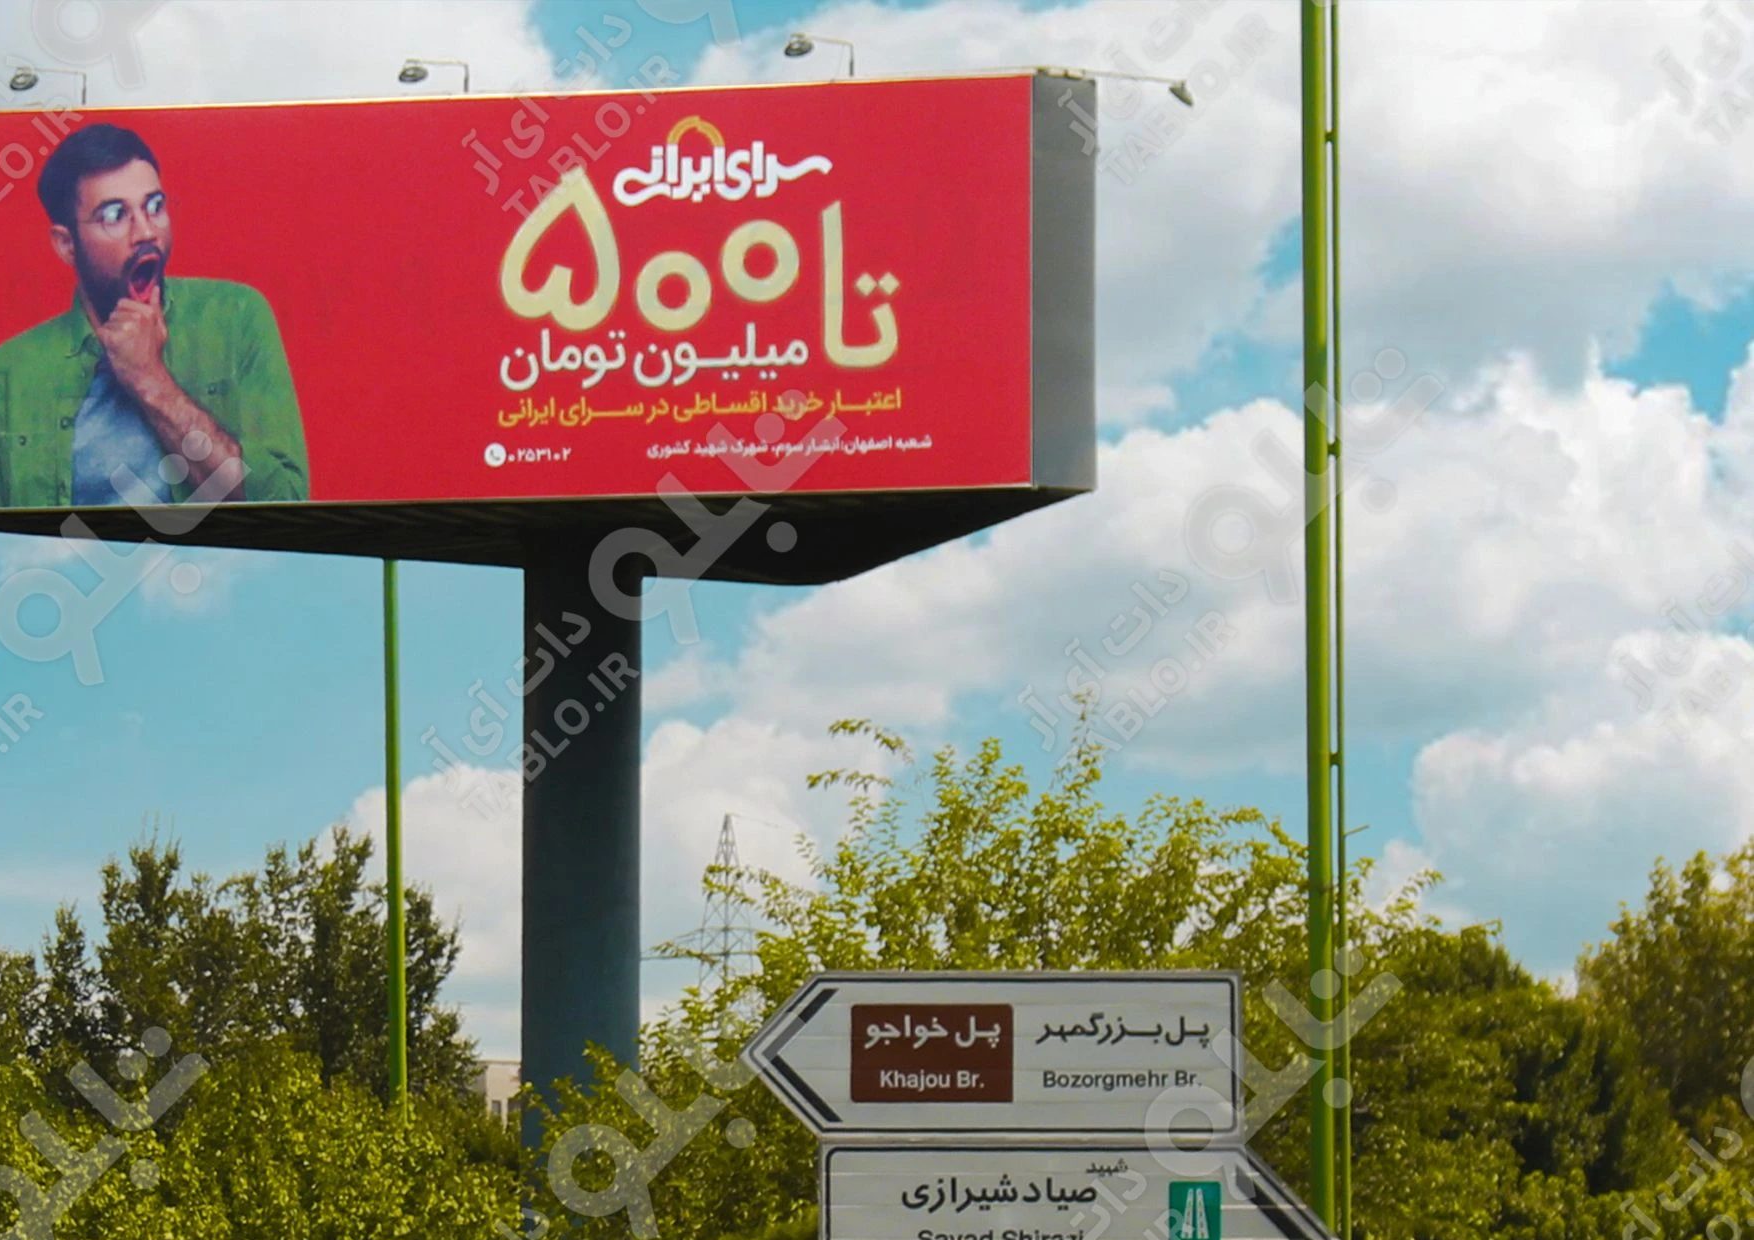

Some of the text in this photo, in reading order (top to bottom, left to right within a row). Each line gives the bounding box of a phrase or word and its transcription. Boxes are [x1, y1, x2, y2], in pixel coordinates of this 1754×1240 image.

[612, 140, 834, 208] سرای ایرانی
[499, 165, 901, 369] تا ۵۰۰
[498, 322, 810, 392] میلیون تومان
[498, 388, 902, 429] اعتبار خرید اقساطی در سرای ایرانی
[693, 440, 729, 457] شهید
[730, 438, 769, 458] شهرک
[895, 433, 933, 453] شعبه
[864, 1014, 1002, 1049] پل خواجو
[1035, 1012, 1211, 1048] پل بزرگمهر
[879, 1070, 986, 1092] Khajou Br.
[1042, 1069, 1203, 1092] Bozorgmehr Br.
[1086, 1158, 1130, 1175] شهید
[901, 1172, 1098, 1214] صیاد شیرازی
